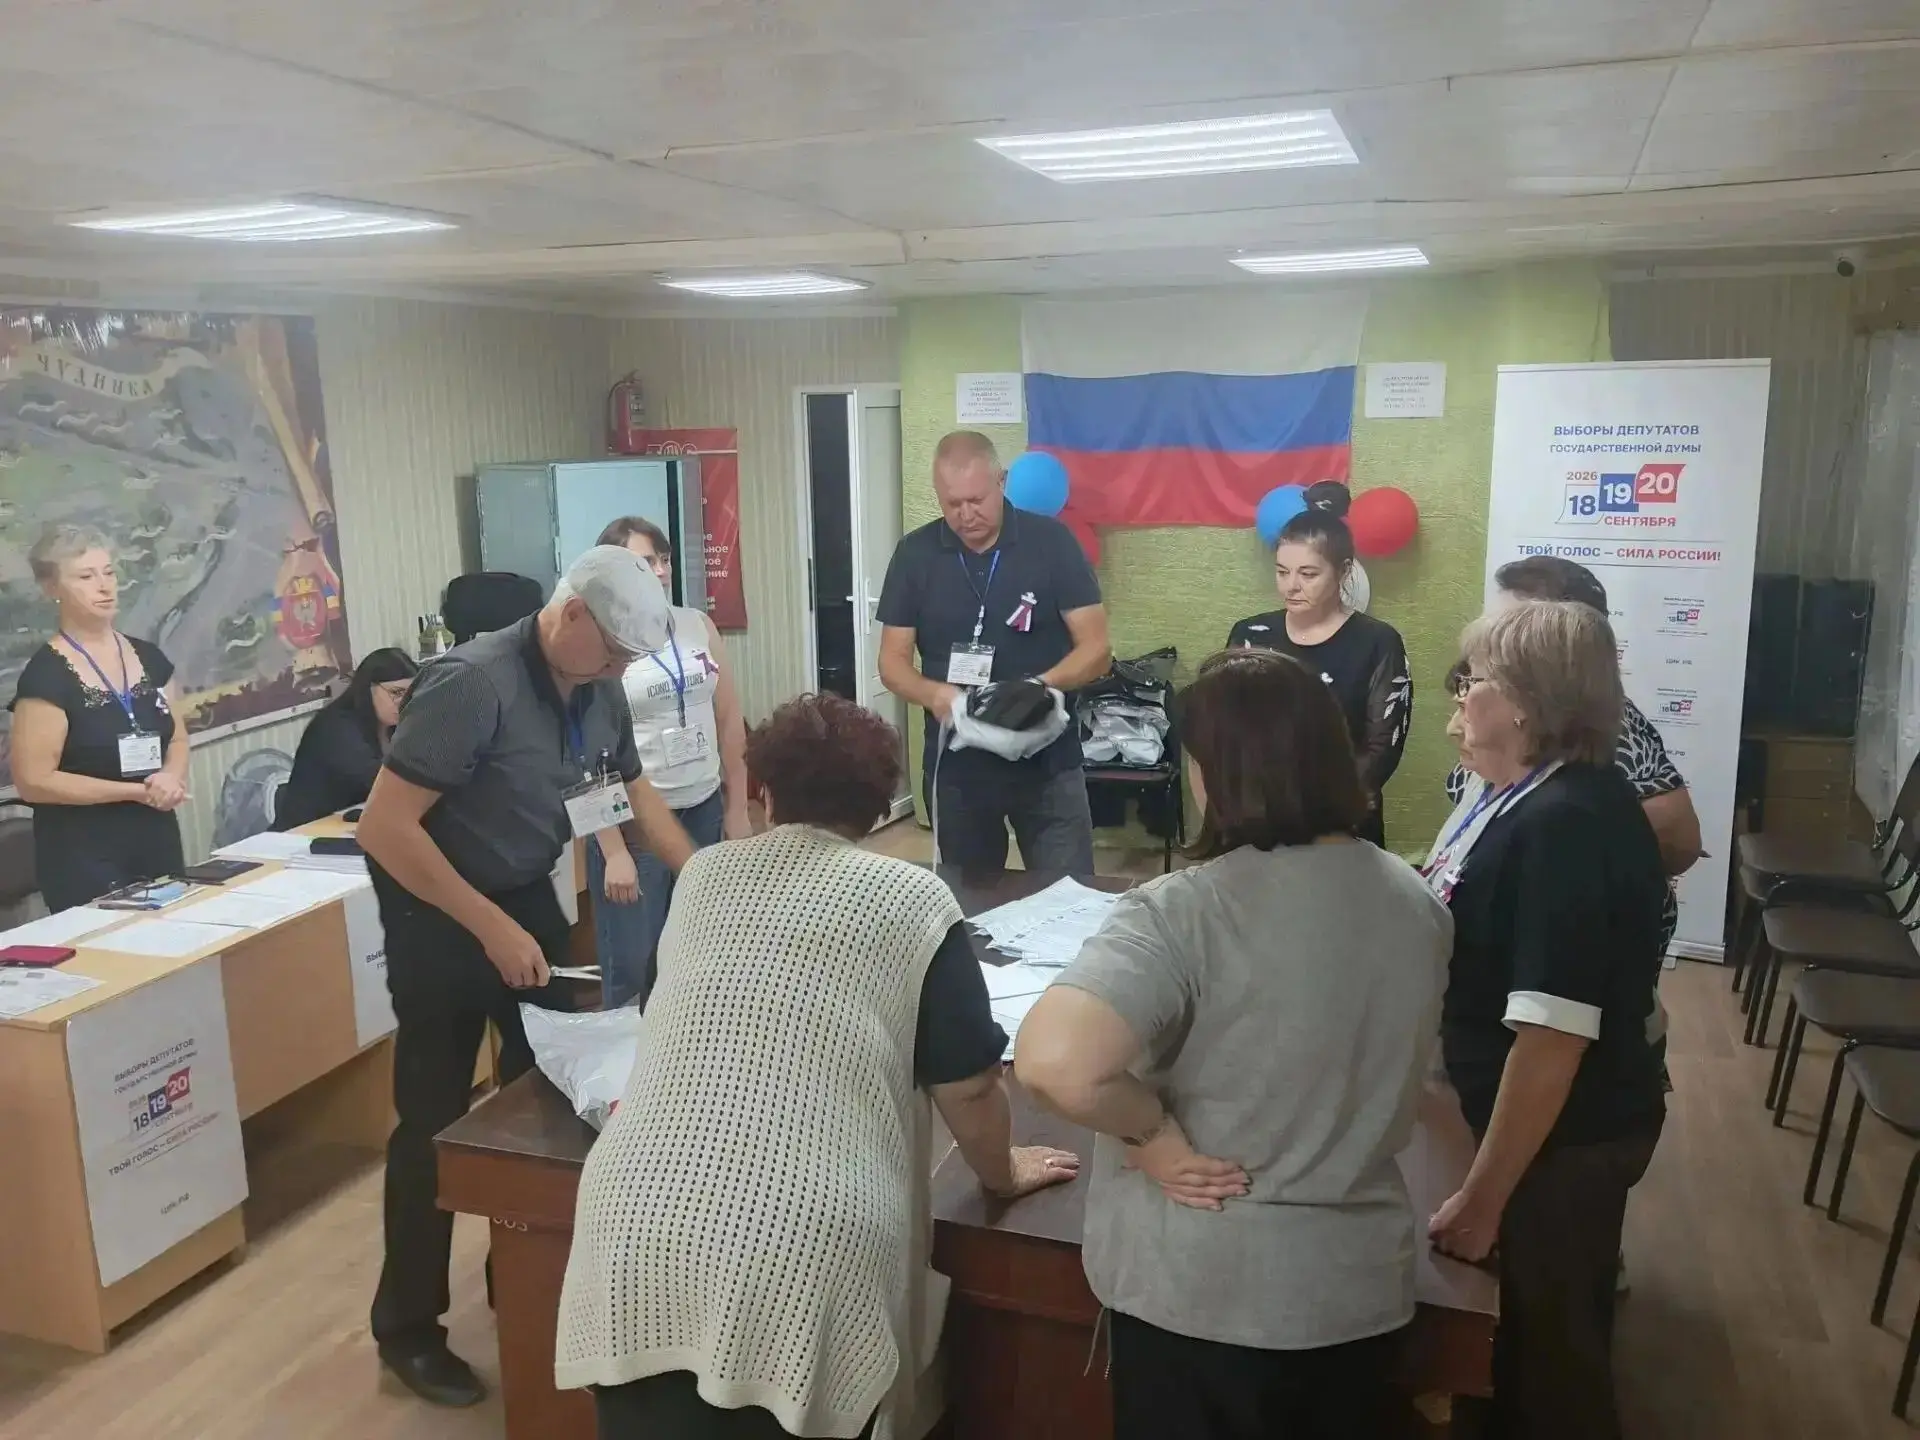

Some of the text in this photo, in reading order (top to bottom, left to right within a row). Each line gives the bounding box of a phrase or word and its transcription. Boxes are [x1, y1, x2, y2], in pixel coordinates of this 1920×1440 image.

[1554, 425, 1699, 437] ВЫБОРЫ ДЕПУТАТОВ
[1550, 443, 1701, 453] ГОСУДАРСТВЕННОЙ ДУМЫ
[1566, 471, 1598, 481] 2026
[1569, 472, 1675, 516] 18 19 20
[1604, 516, 1676, 527] СЕНТЯБРЯ
[1518, 544, 1552, 555] ТВОЙ
[1556, 547, 1600, 557] ГОЛОС
[1617, 548, 1654, 558] СИЛА
[1659, 549, 1720, 561] РОССИИ!
[133, 1112, 149, 1132] 18
[150, 1093, 167, 1114] 19
[168, 1075, 188, 1097] 20
